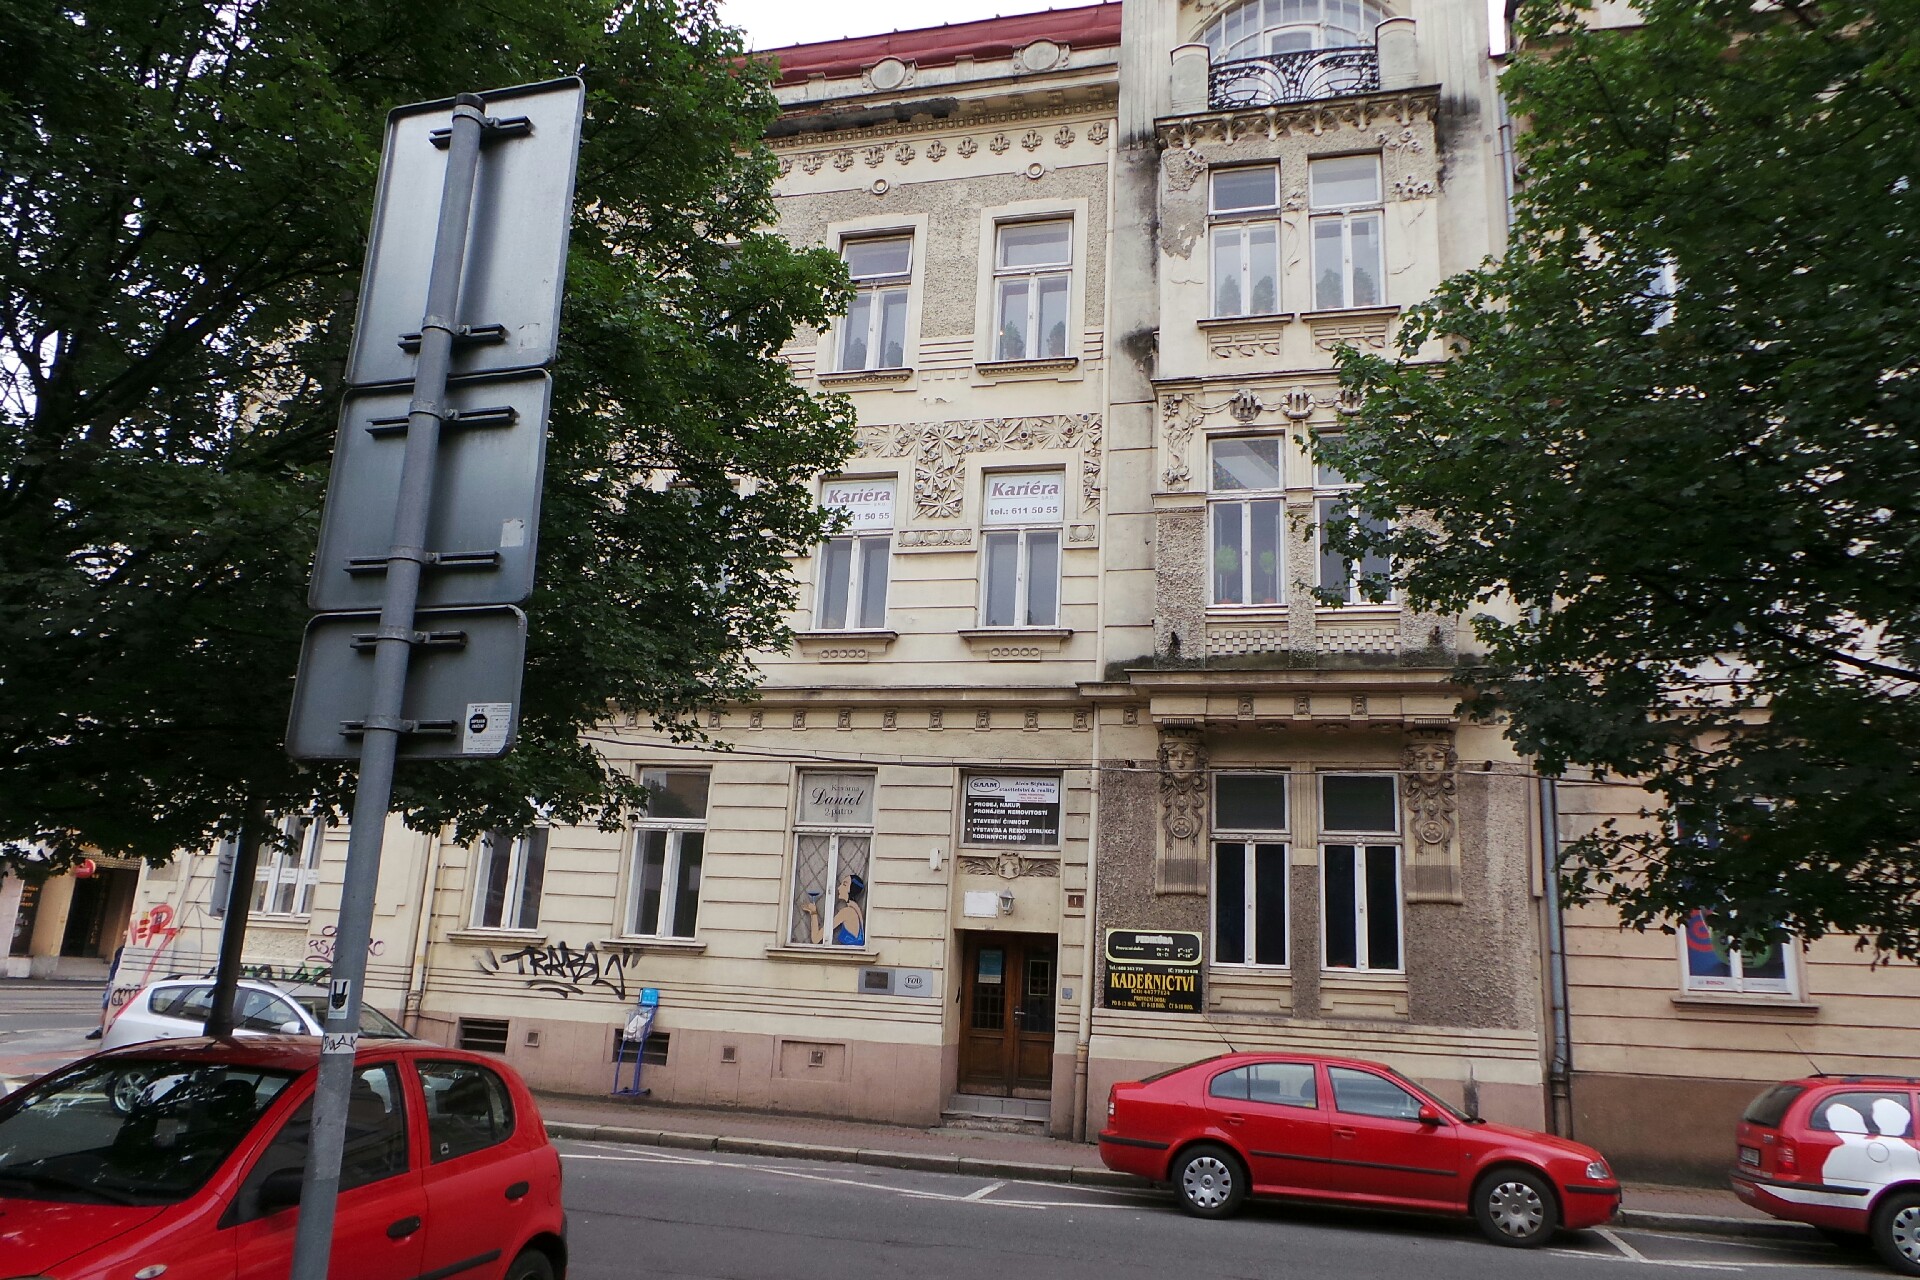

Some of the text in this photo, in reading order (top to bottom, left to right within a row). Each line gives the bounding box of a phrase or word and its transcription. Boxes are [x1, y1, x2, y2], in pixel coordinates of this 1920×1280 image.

[828, 488, 891, 504] Kariéra
[991, 480, 1059, 497] Kariéra
[864, 512, 876, 520] 50
[878, 512, 890, 520] 55
[990, 506, 1058, 516] tel.: 611 50 55
[810, 787, 865, 806] Daniel
[1110, 972, 1195, 992] KADEŘNICTVÍ
